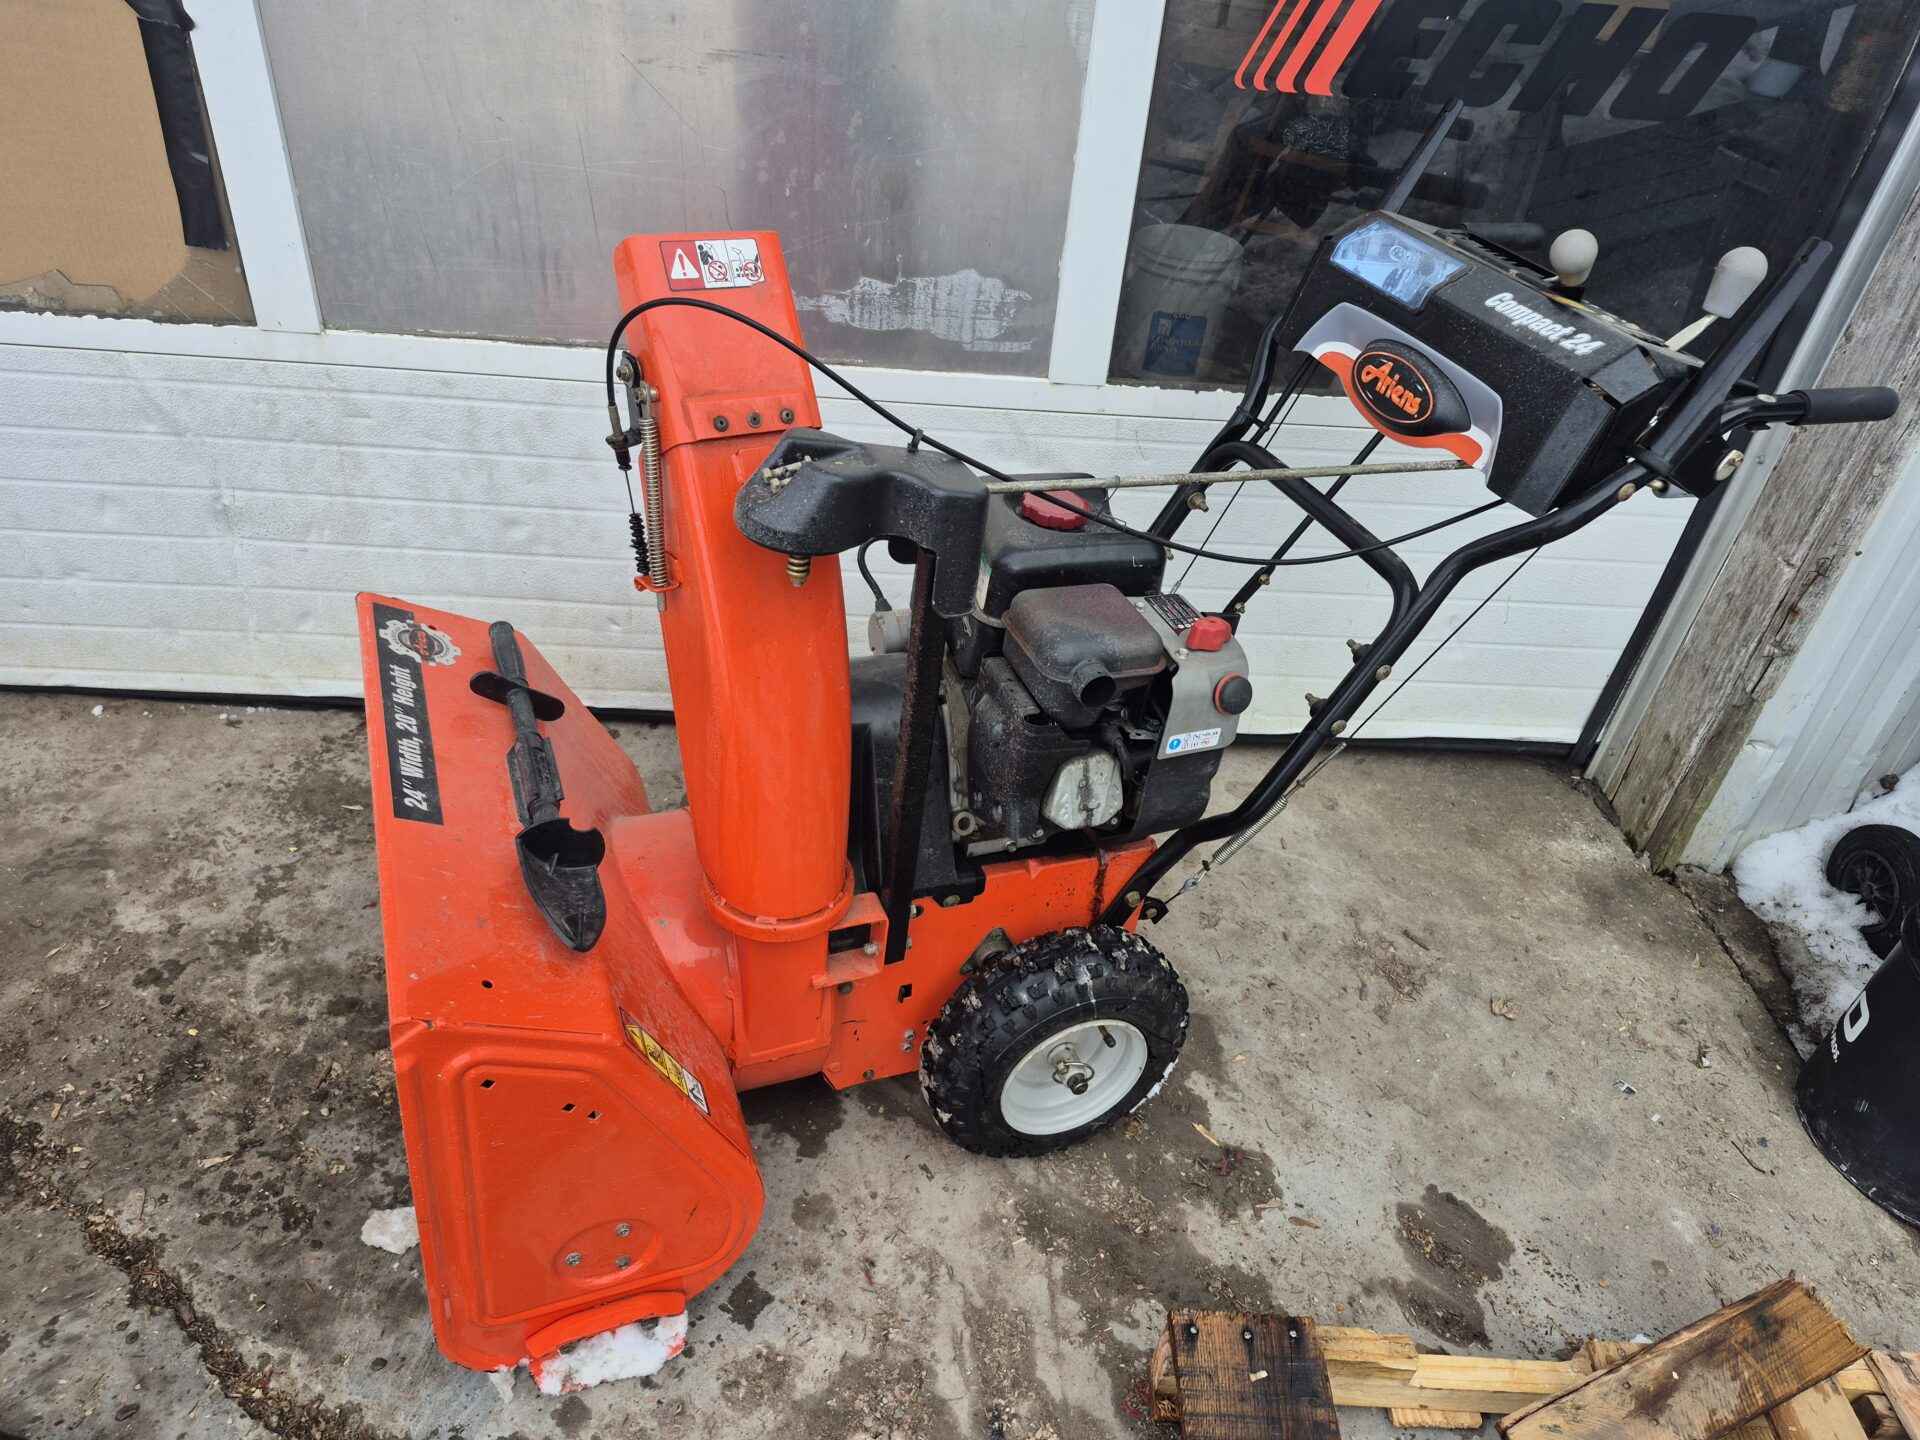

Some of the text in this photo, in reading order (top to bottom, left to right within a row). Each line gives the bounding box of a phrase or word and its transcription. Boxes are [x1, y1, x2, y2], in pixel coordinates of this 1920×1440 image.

[1341, 0, 1758, 120] ECHO
[1484, 292, 1606, 356] Compact 24
[1361, 361, 1422, 415] Ariens
[388, 663, 417, 708] Height
[393, 704, 419, 735] 20"
[397, 737, 425, 779] Width,
[402, 778, 429, 812] 24"
